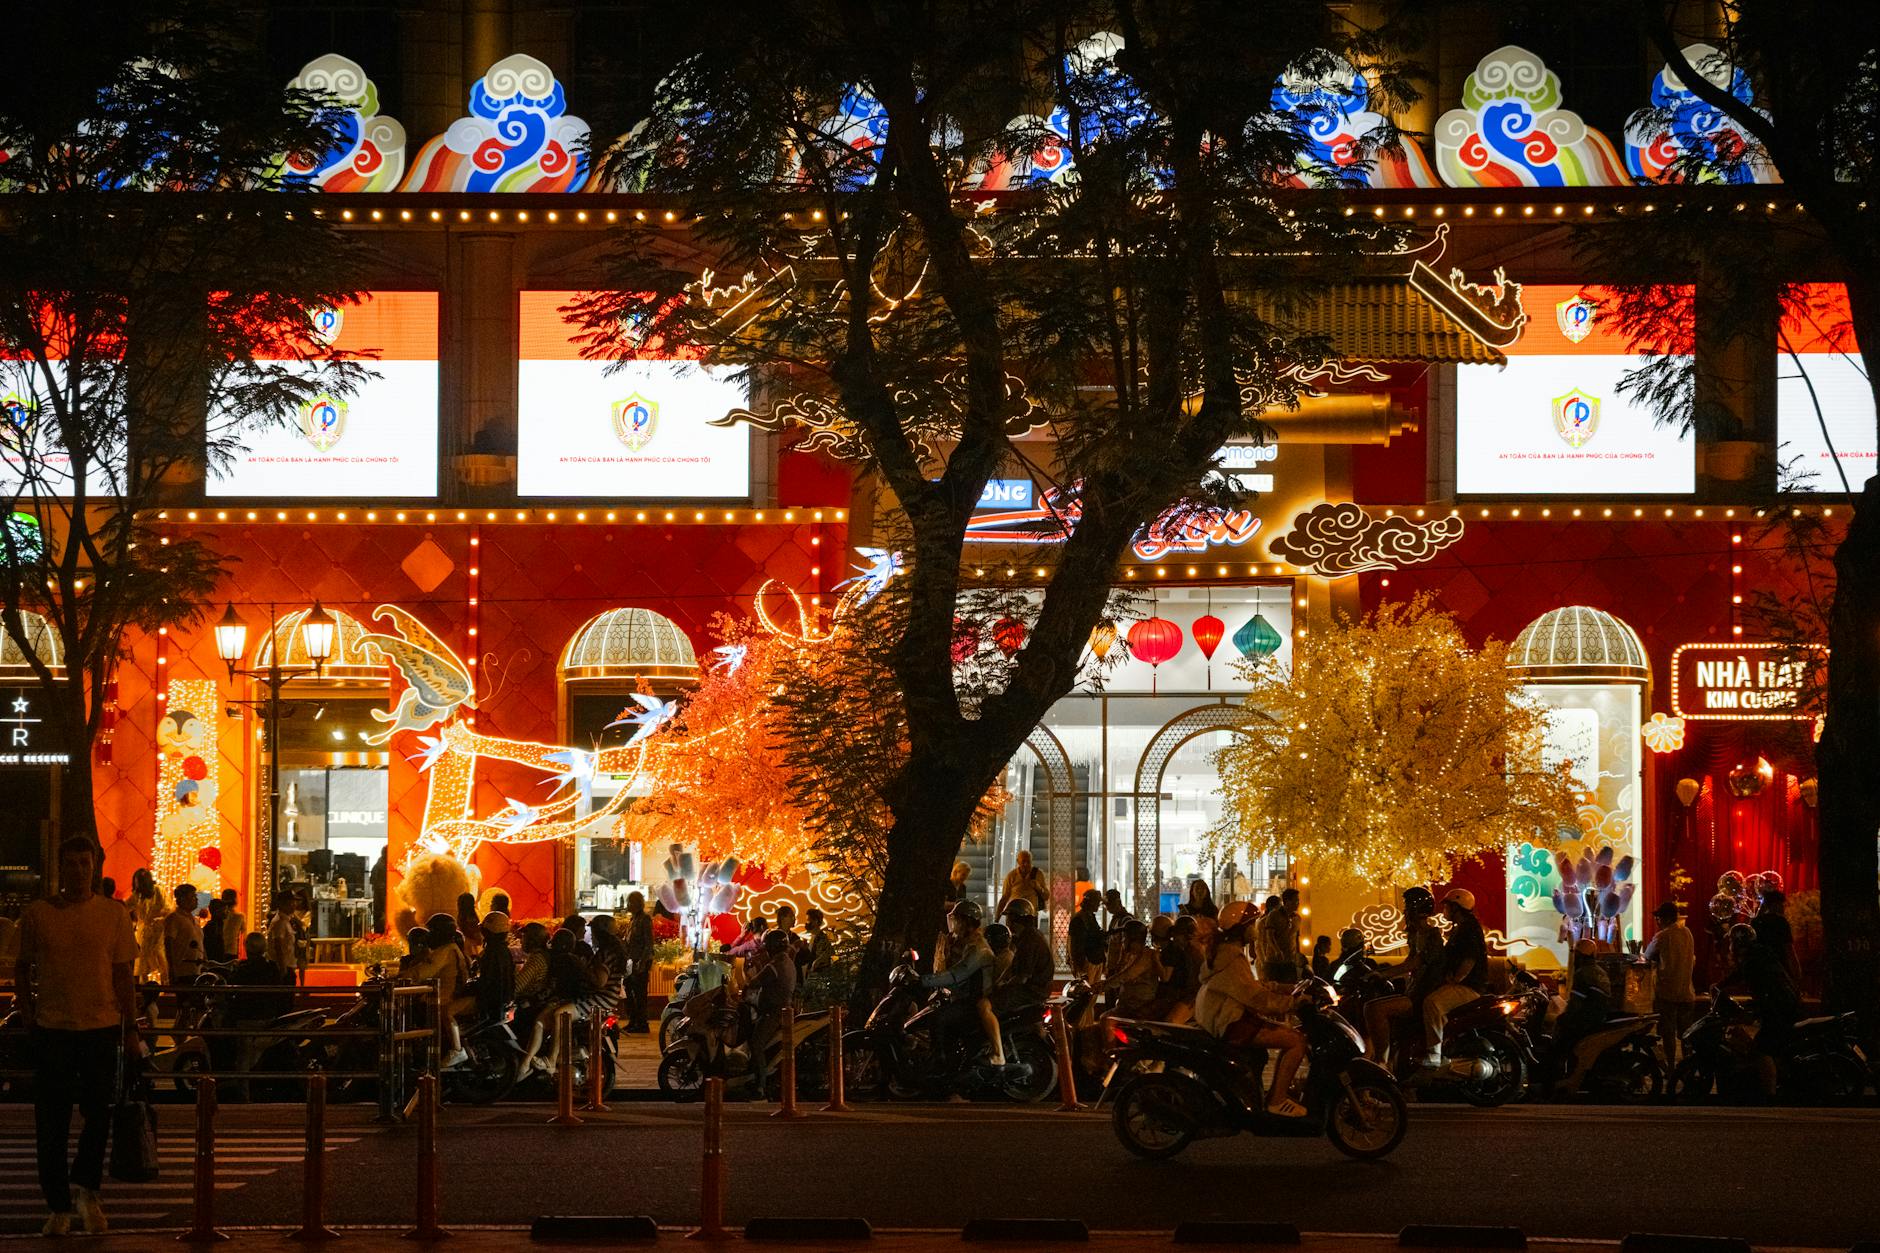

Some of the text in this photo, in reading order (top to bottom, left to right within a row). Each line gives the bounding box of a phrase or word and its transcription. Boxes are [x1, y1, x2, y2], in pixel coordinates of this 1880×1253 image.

[1215, 444, 1277, 460] amond
[1696, 655, 1808, 688] NHÀ HÁT
[1706, 690, 1738, 708] KIM
[12, 728, 28, 746] R
[328, 811, 384, 826] CLINIQUE
